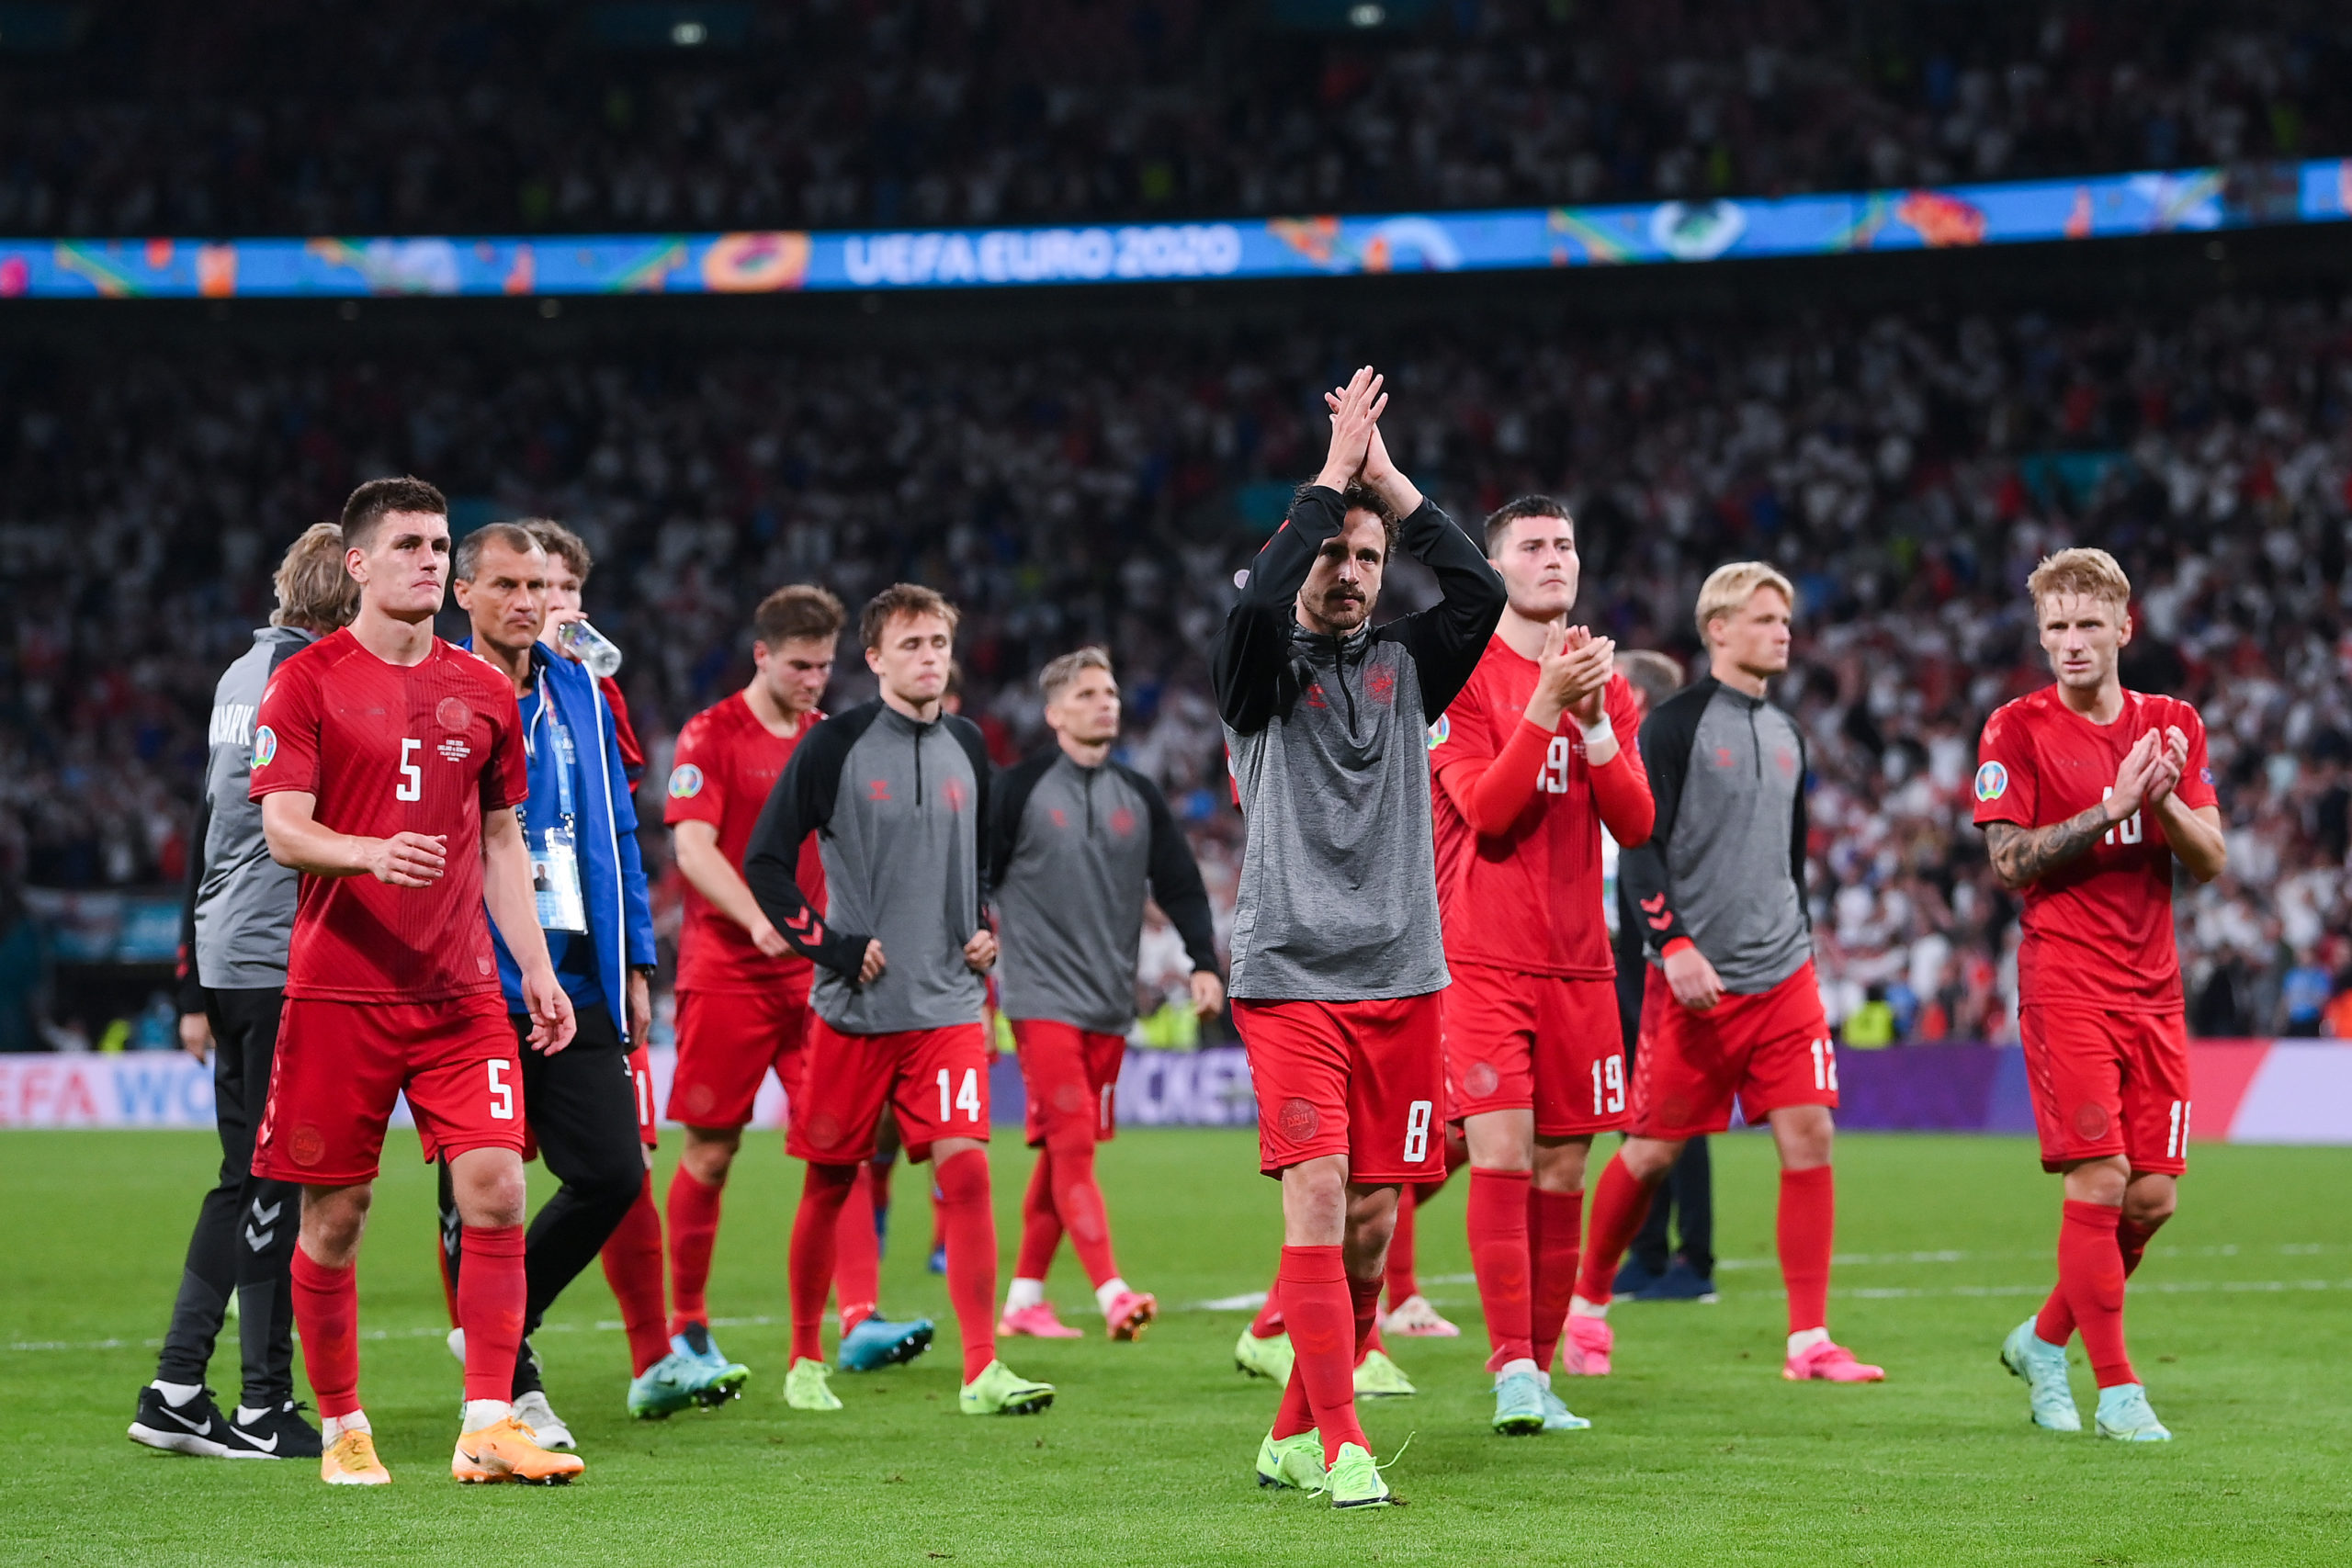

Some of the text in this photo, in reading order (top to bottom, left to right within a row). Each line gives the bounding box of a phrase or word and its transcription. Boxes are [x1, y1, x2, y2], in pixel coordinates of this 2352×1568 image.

[843, 223, 1240, 286] UEFA EURO 2020
[396, 738, 422, 802] 5
[487, 1059, 514, 1119] 5
[936, 1068, 980, 1122] 14
[1591, 1054, 1625, 1115] 19
[1403, 1100, 1432, 1162] 8
